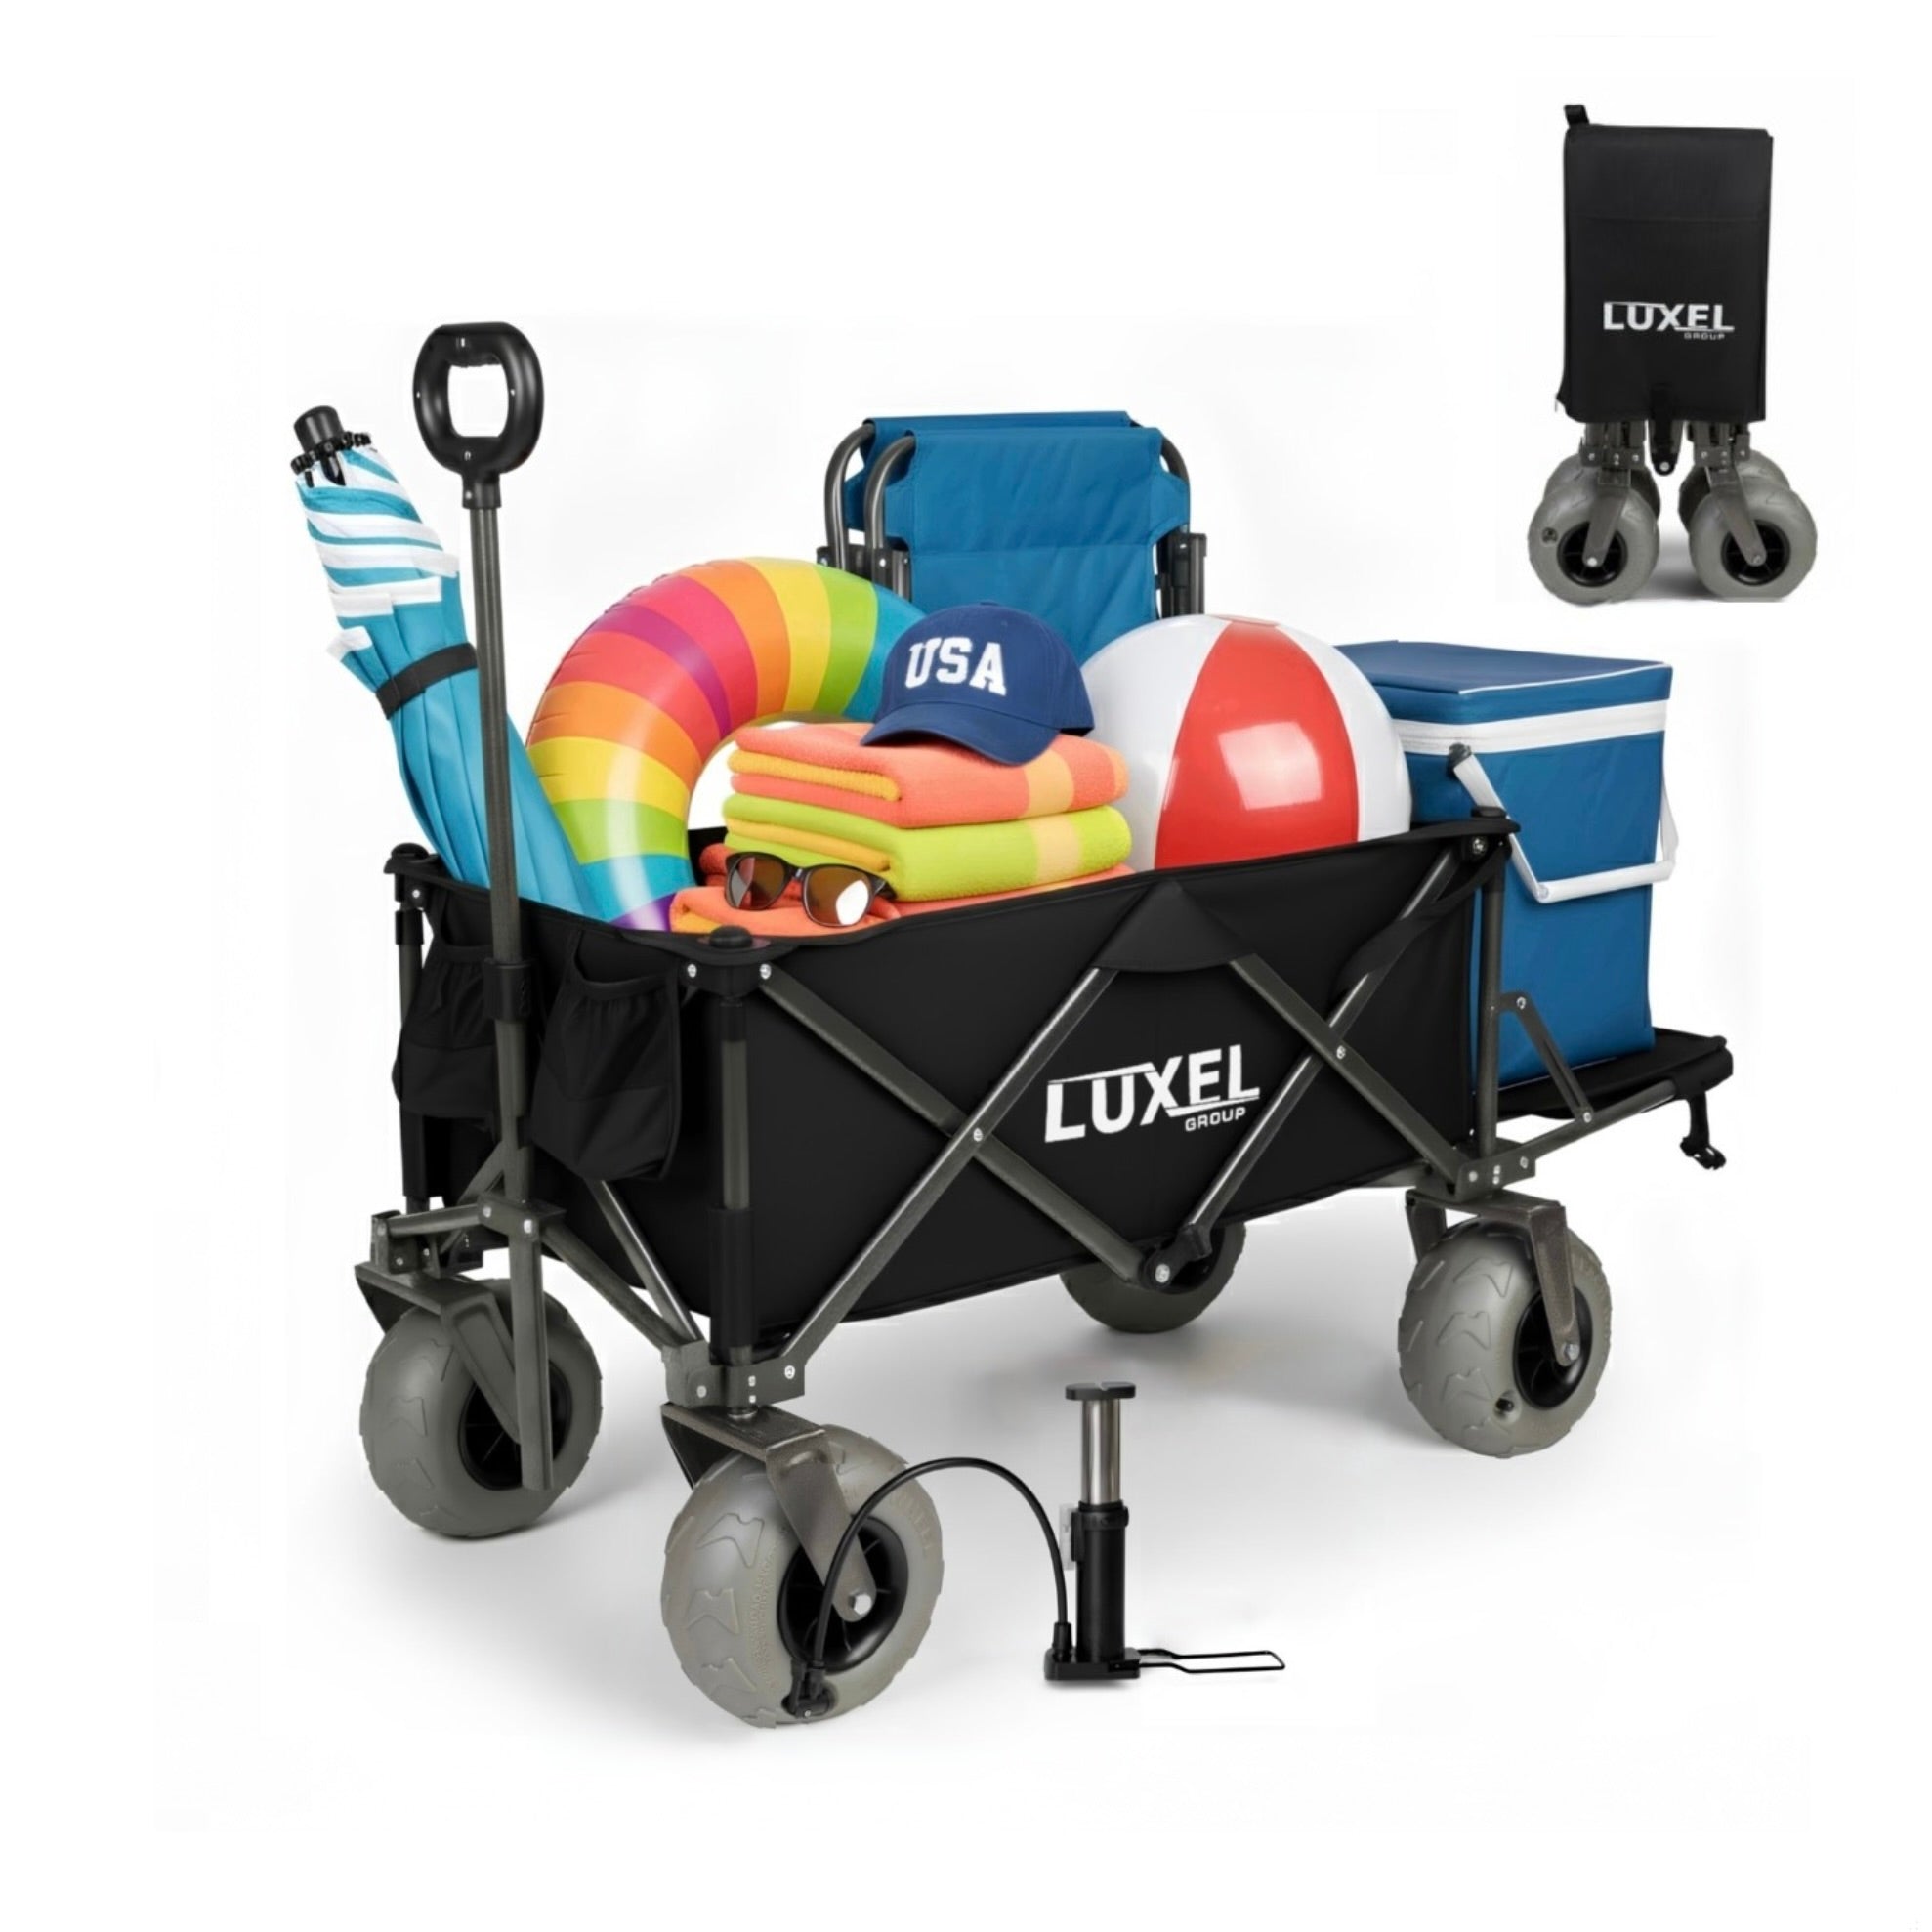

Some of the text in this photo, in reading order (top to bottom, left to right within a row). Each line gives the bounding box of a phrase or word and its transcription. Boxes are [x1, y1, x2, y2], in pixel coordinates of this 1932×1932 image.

[1603, 301, 1735, 332] LUXEL
[1684, 332, 1725, 341] GROUP
[904, 636, 1007, 696] USA
[1045, 1044, 1260, 1143] LUXEL
[1185, 1107, 1246, 1132] GROUP
